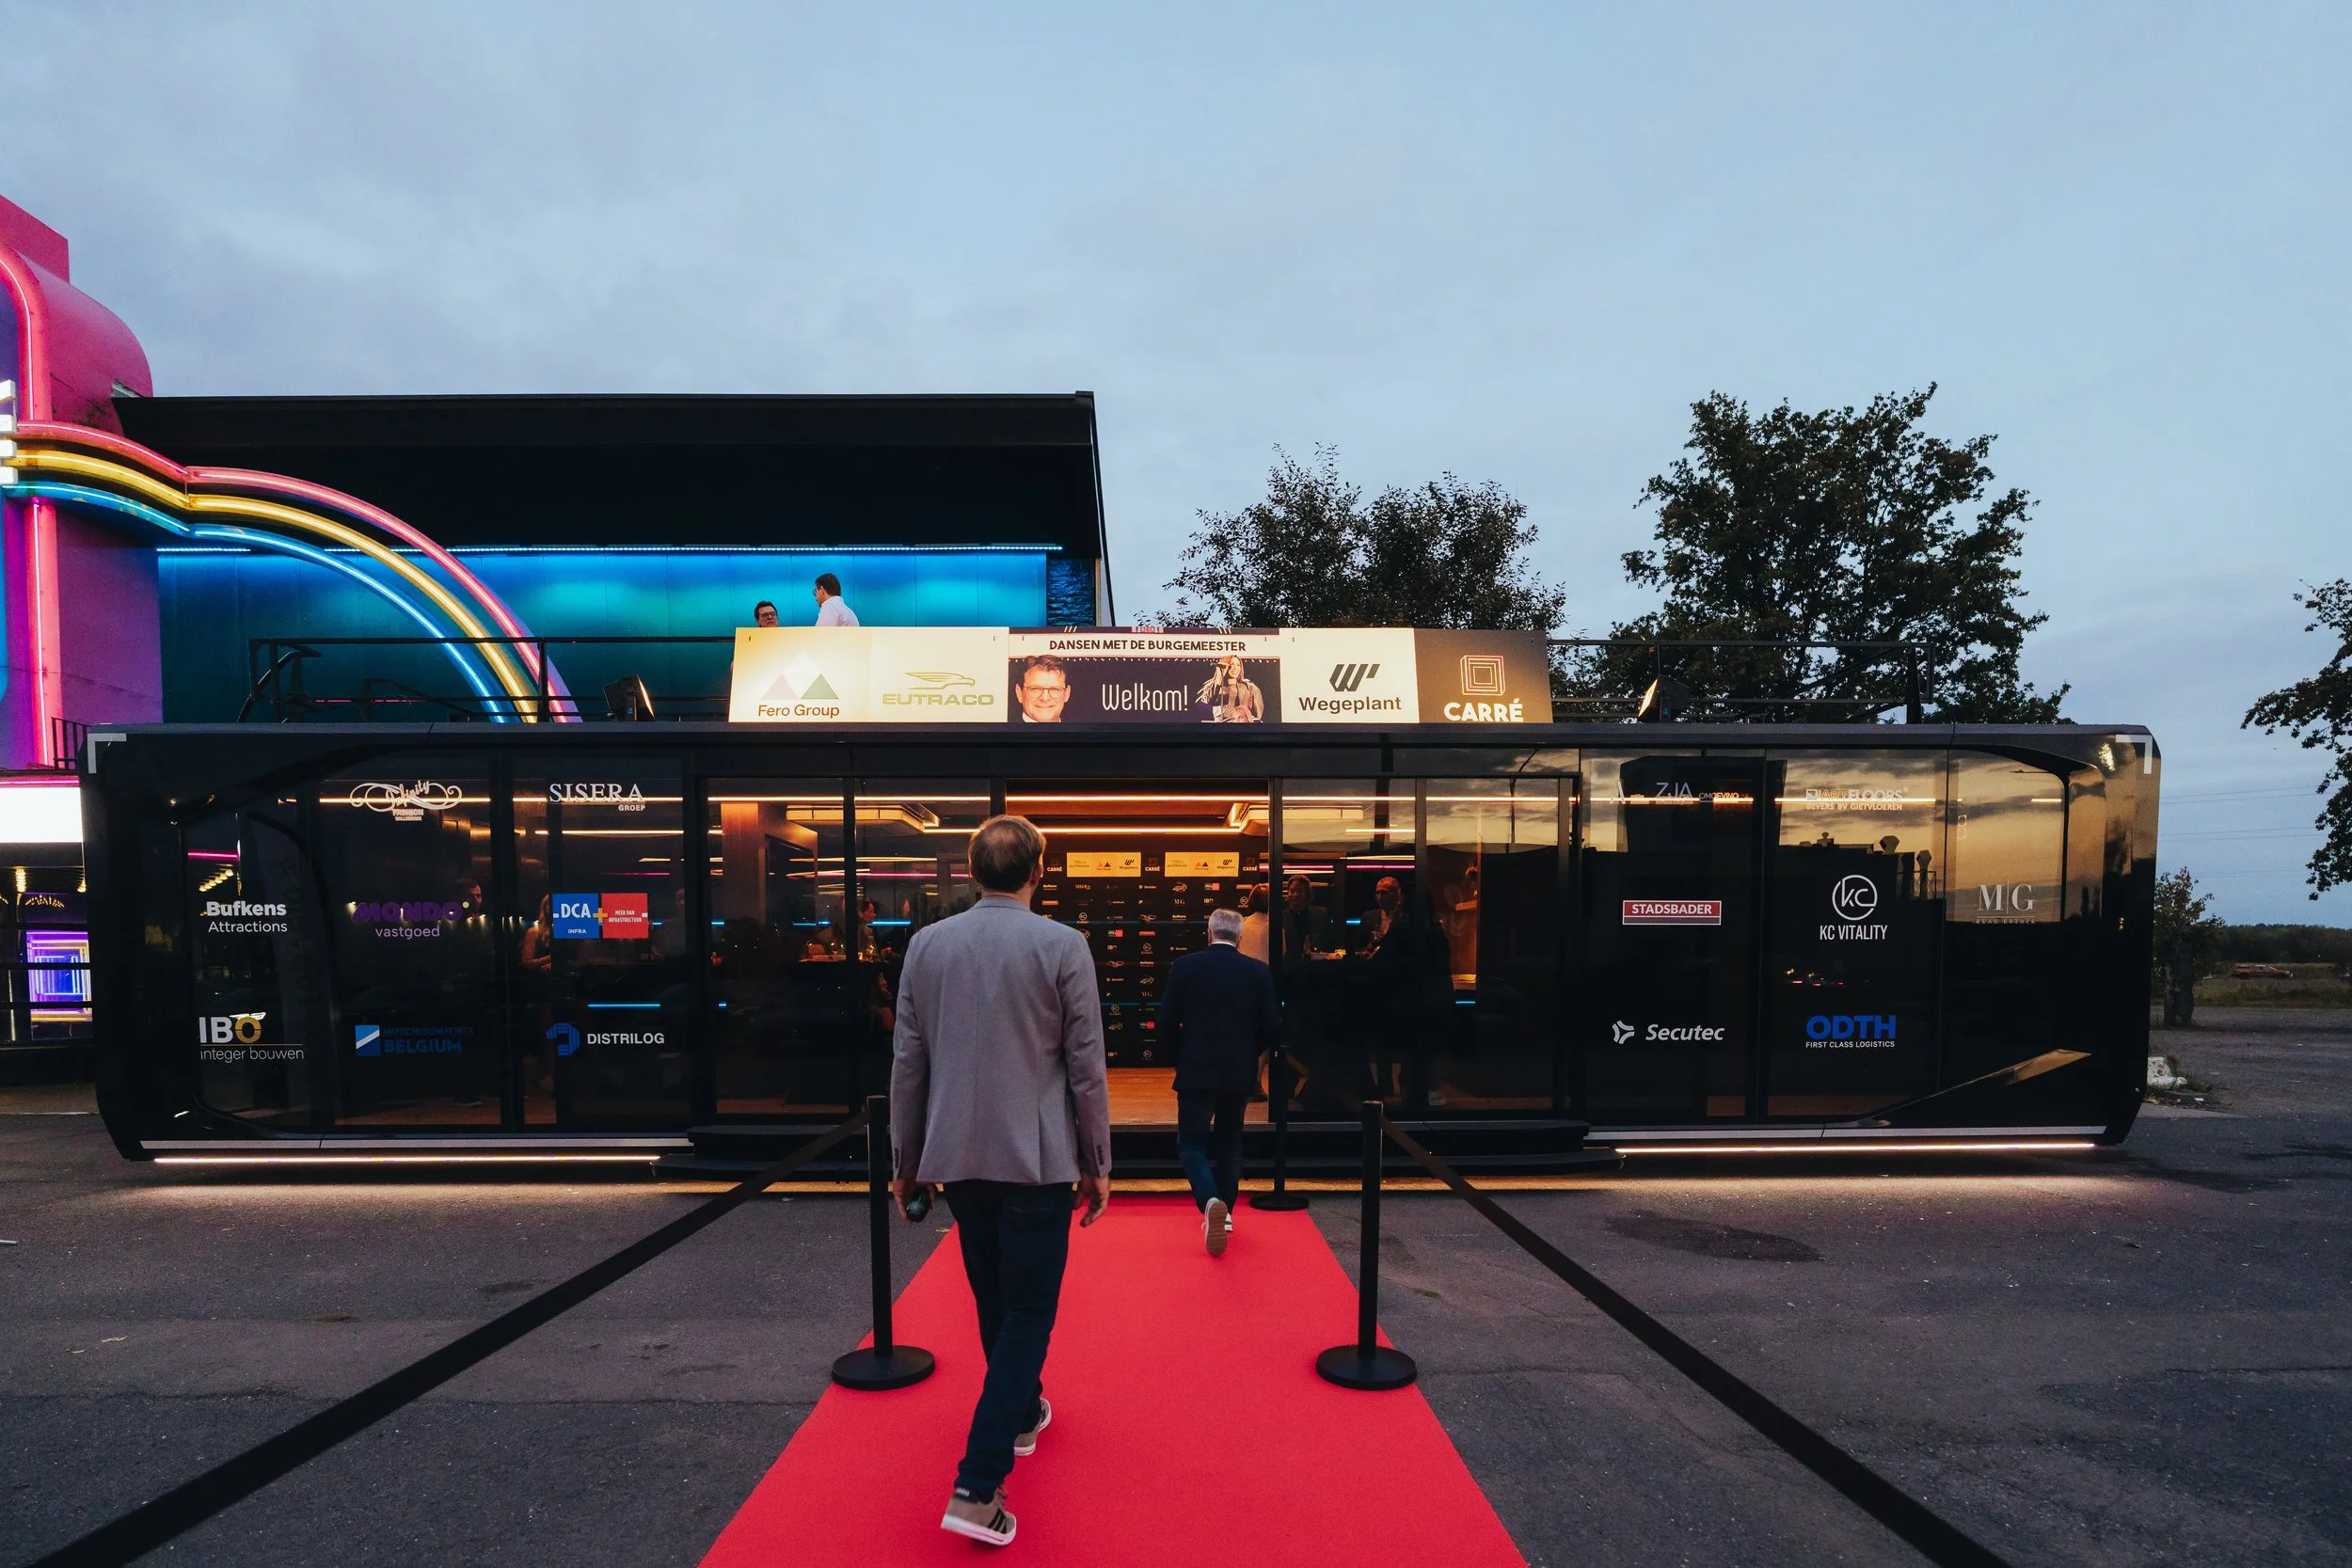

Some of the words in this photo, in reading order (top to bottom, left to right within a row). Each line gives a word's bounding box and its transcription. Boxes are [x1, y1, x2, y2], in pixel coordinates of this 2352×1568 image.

[1049, 640, 1101, 650] DANSEN
[1103, 640, 1128, 650] MET
[1130, 641, 1146, 650] DE
[1148, 641, 1247, 652] BURGEMEESTER
[882, 693, 994, 706] EUTRACO
[1102, 683, 1188, 712] Welkom!
[1298, 696, 1402, 715] Wegeplant
[757, 705, 790, 717] Fero
[793, 705, 841, 720] Group
[1443, 698, 1524, 722] CARRÉ
[548, 783, 645, 803] SISERA
[617, 804, 647, 813] GROEP
[1850, 802, 1903, 811] GIETVLOEREN
[206, 900, 287, 917] Bufkens
[350, 901, 462, 924] MONDO
[561, 903, 592, 919] DCA
[1631, 903, 1712, 915] STADSBADER
[208, 920, 288, 933] Attractions
[374, 925, 440, 941] vastgoed
[1820, 925, 1836, 941] KC
[1837, 925, 1888, 941] VITALITY
[199, 1017, 262, 1044] IBO
[1645, 1023, 1725, 1041] Secutec
[1805, 1014, 1897, 1039] ODTH
[383, 1038, 463, 1053] BELGIUM
[587, 1032, 665, 1045] DISTRILOG
[199, 1048, 246, 1064] integer
[249, 1046, 305, 1060] bouwen
